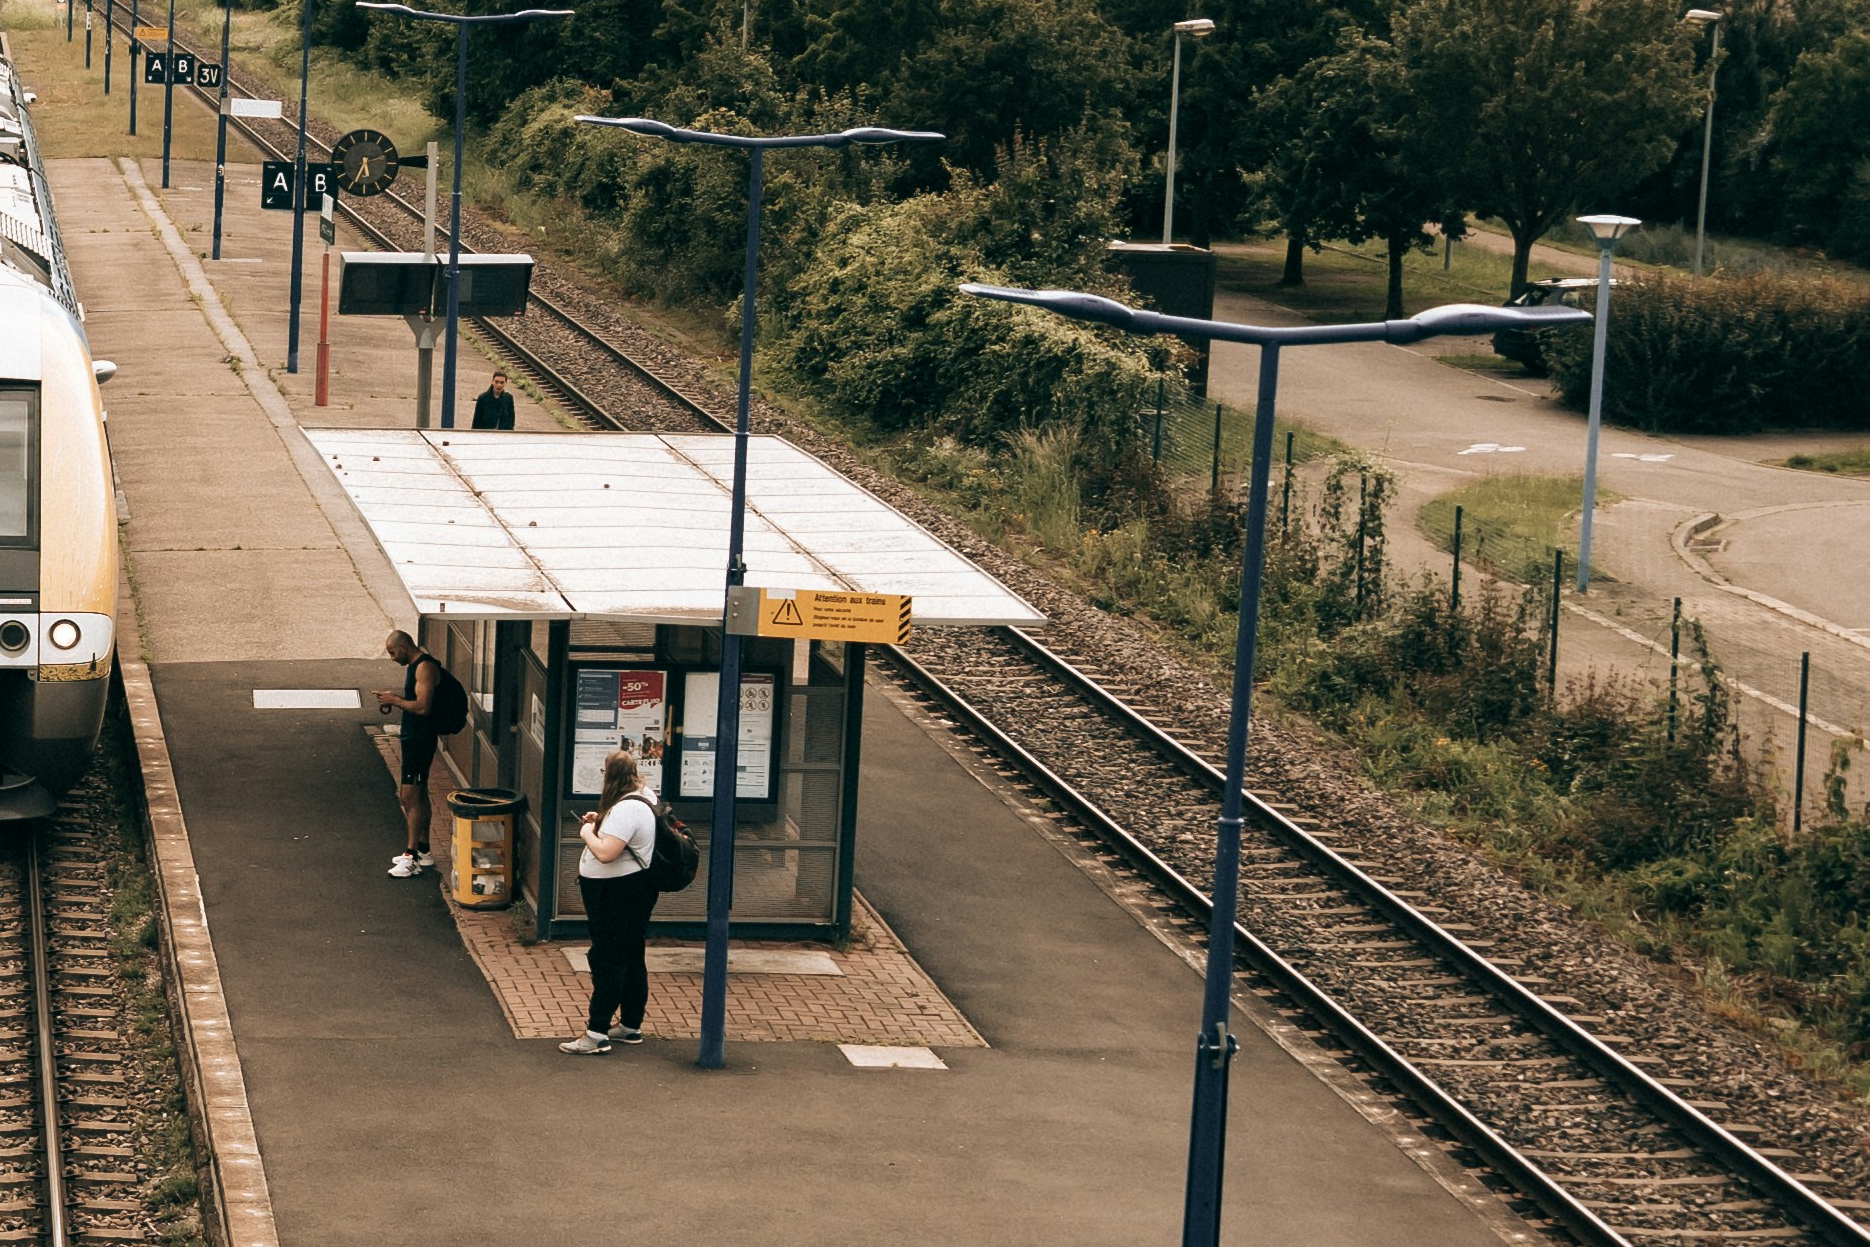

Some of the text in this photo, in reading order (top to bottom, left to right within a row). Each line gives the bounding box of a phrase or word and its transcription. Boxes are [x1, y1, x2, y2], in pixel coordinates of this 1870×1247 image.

[151, 59, 162, 71] A
[178, 60, 188, 73] B
[199, 68, 218, 84] 3V
[273, 172, 288, 192] A
[315, 173, 327, 192] B
[814, 594, 847, 603] Attention
[866, 597, 886, 605] trains
